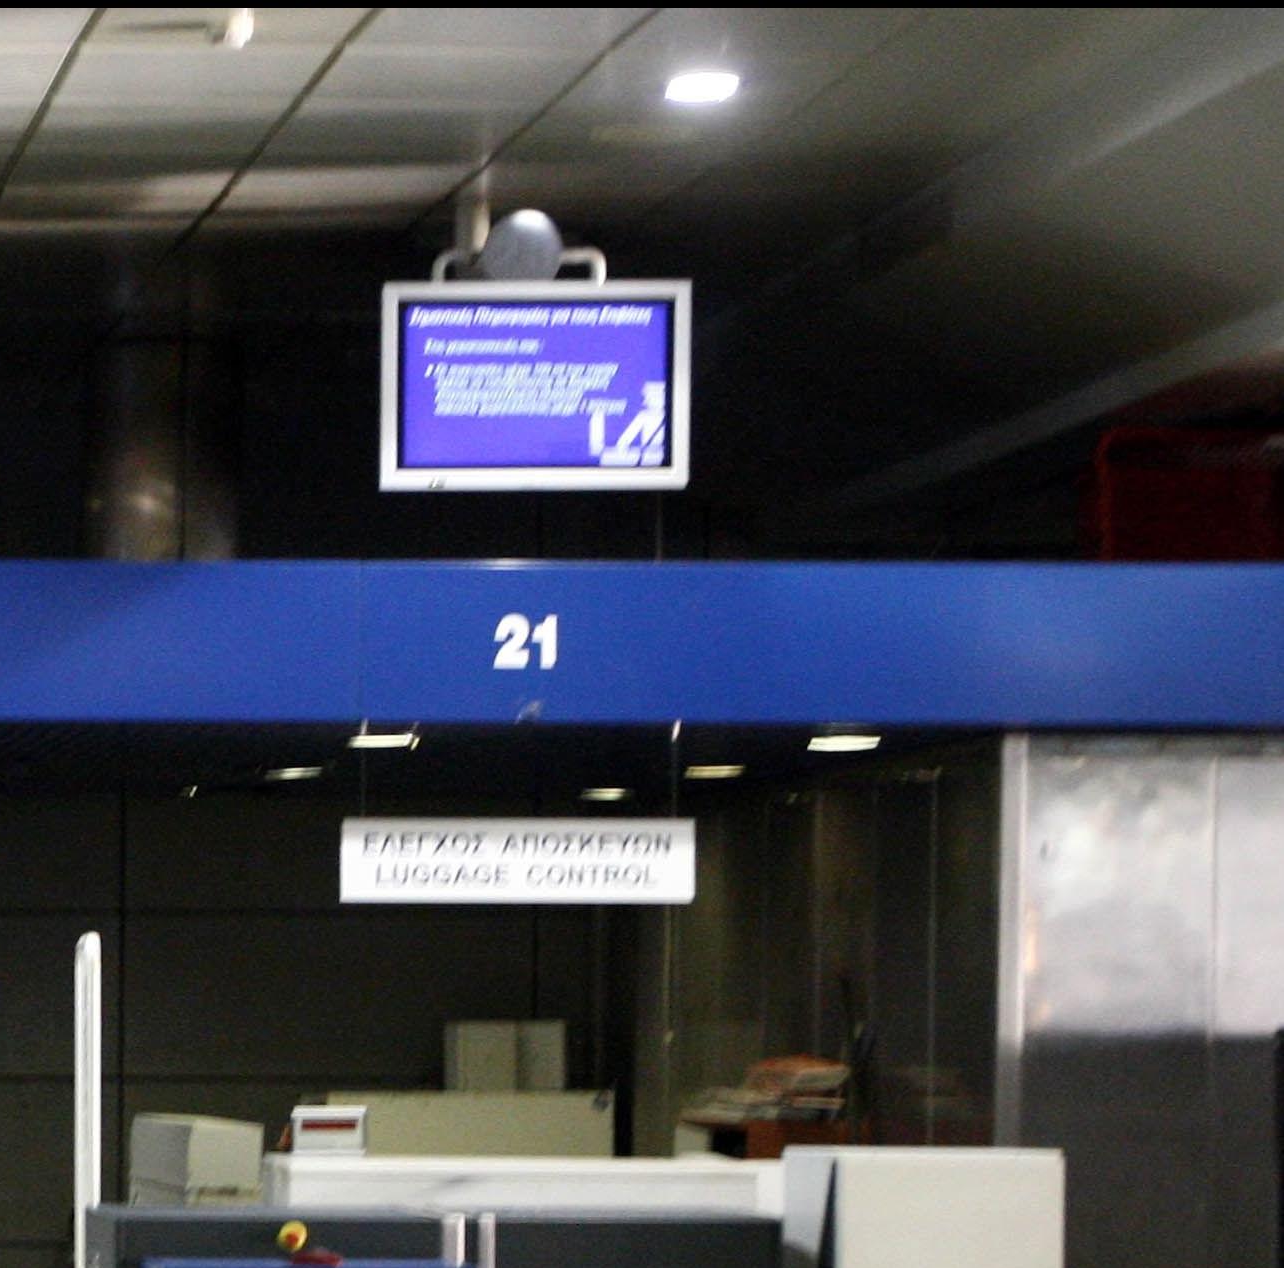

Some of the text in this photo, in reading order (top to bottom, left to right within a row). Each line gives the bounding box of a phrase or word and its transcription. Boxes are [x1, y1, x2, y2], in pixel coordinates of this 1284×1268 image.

[493, 613, 558, 669] 21
[375, 863, 659, 886] LUGGAGE CONTROL
